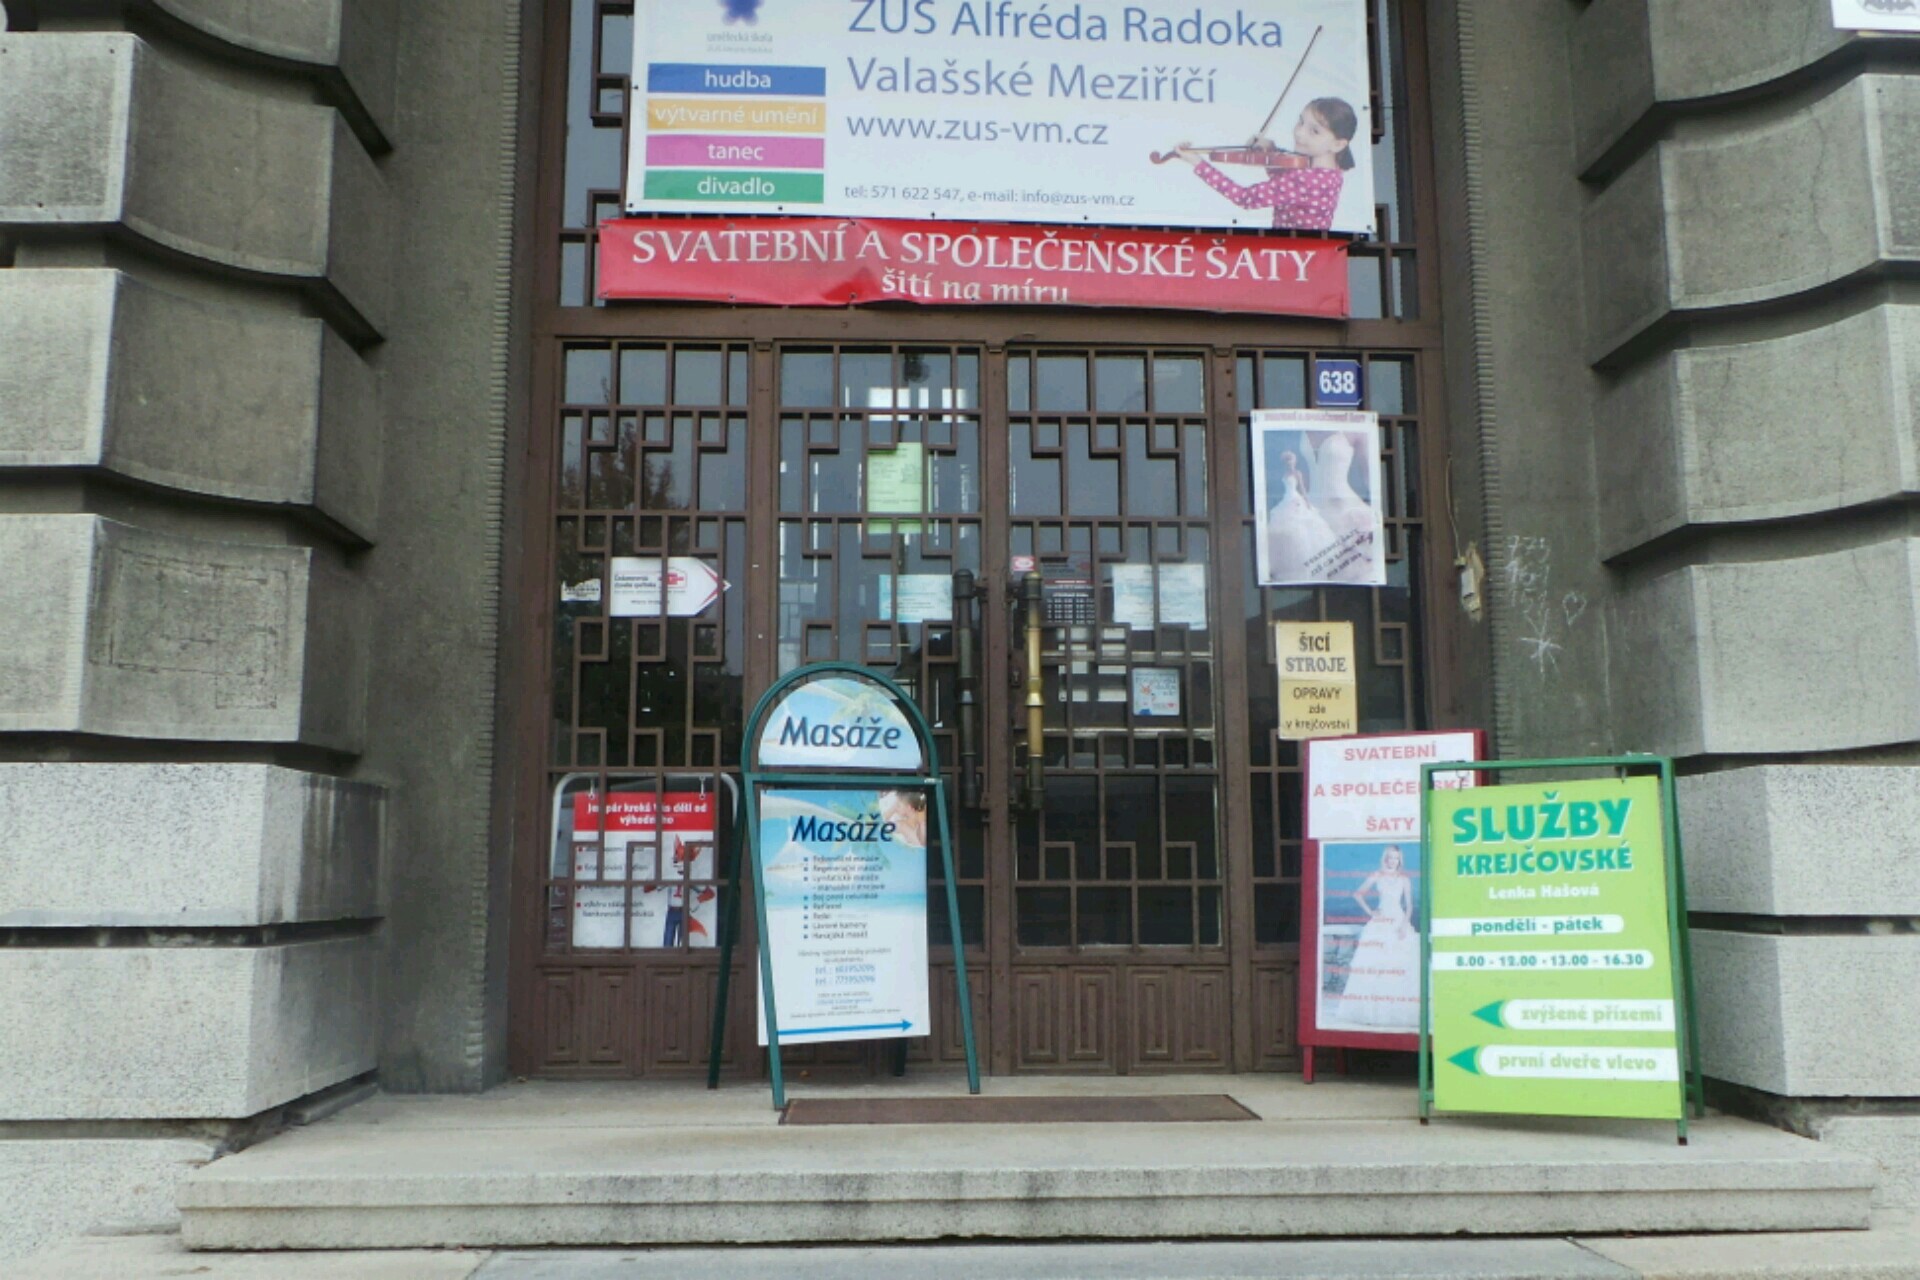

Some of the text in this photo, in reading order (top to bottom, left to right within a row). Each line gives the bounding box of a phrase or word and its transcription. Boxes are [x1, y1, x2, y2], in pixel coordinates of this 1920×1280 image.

[951, 0, 1107, 41] Alfréda
[1124, 8, 1281, 47] Radoka
[704, 69, 771, 88] hudba
[847, 57, 1217, 103] Valašské Meziříčí
[655, 104, 817, 126] výtvarné umění
[847, 115, 1109, 145] www.zus-vm.cz
[708, 143, 764, 161] tanec
[697, 176, 775, 196] divadlo
[845, 186, 868, 199] tel:
[872, 186, 898, 200] 571
[902, 187, 929, 200] 622
[967, 189, 1018, 203] e-mail:
[1022, 190, 1135, 207] info@zus-vm.cz
[632, 223, 1316, 282] SVATEBNÍ A SPOLEČENSKÉ ŠATY
[881, 267, 933, 297] šití
[1319, 371, 1356, 394] 638
[1298, 632, 1331, 652] ŠICÍ
[1285, 657, 1347, 672] STROJE
[1293, 687, 1341, 699] OPRAVY
[1308, 704, 1326, 714] zde
[779, 716, 901, 750] Masáže
[1344, 741, 1437, 760] SVATEBNÍ
[1313, 783, 1326, 797] A
[1366, 817, 1415, 832] ŠATY
[1452, 791, 1633, 844] SLUŽBY
[792, 815, 896, 842] Masáže
[1456, 842, 1633, 876] KREJČOVSKÉ
[1489, 885, 1536, 899] Lenka
[1553, 916, 1603, 933] pátek
[1456, 954, 1485, 967] 8.00
[1499, 954, 1537, 966] 12.00
[1551, 953, 1588, 966] 13.00
[1604, 952, 1644, 966] 16.30
[1498, 1051, 1657, 1070] první dveře vlevo
